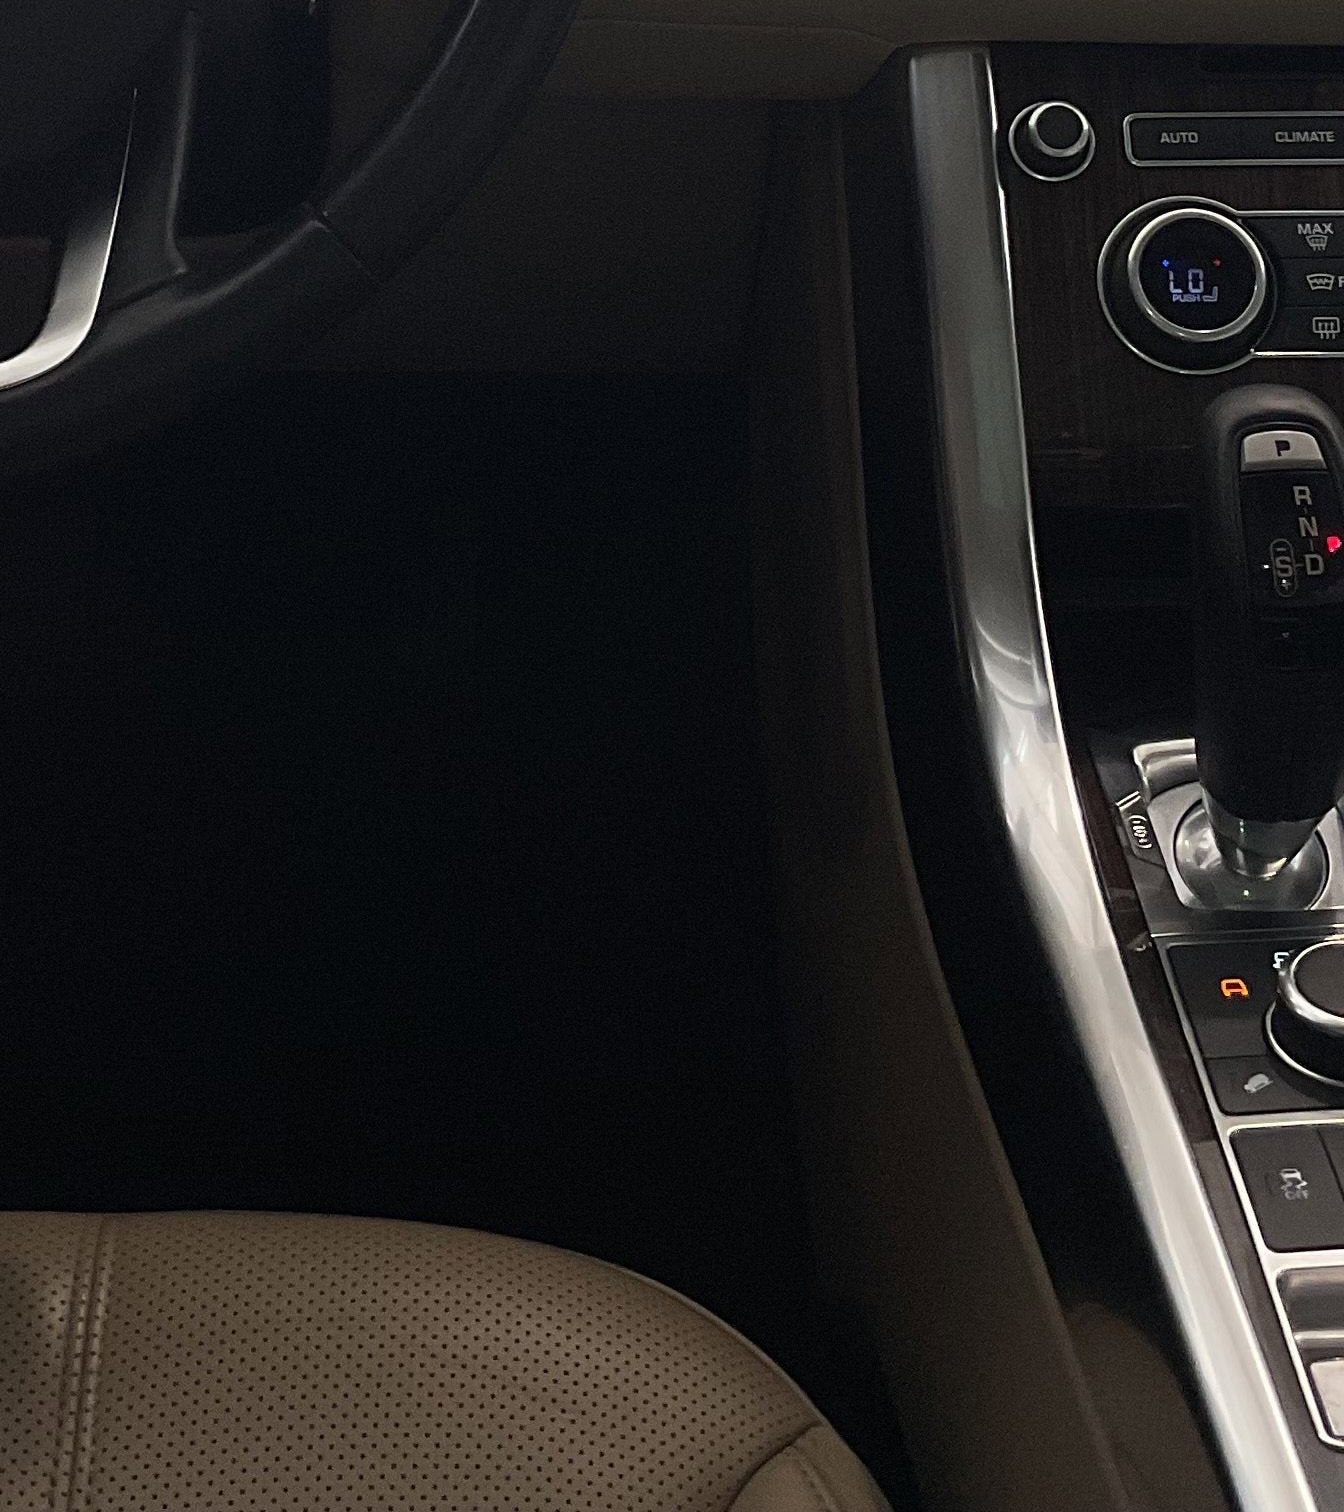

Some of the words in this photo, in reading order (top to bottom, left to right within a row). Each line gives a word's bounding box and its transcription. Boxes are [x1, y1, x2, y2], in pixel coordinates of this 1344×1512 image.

[1160, 132, 1199, 144] AUTO
[1274, 131, 1336, 144] CLIMATE
[1297, 223, 1334, 235] MAX
[1275, 440, 1291, 457] P
[1292, 485, 1313, 506] R
[1298, 516, 1319, 537] N
[1275, 555, 1294, 578] S
[1304, 553, 1325, 575] D
